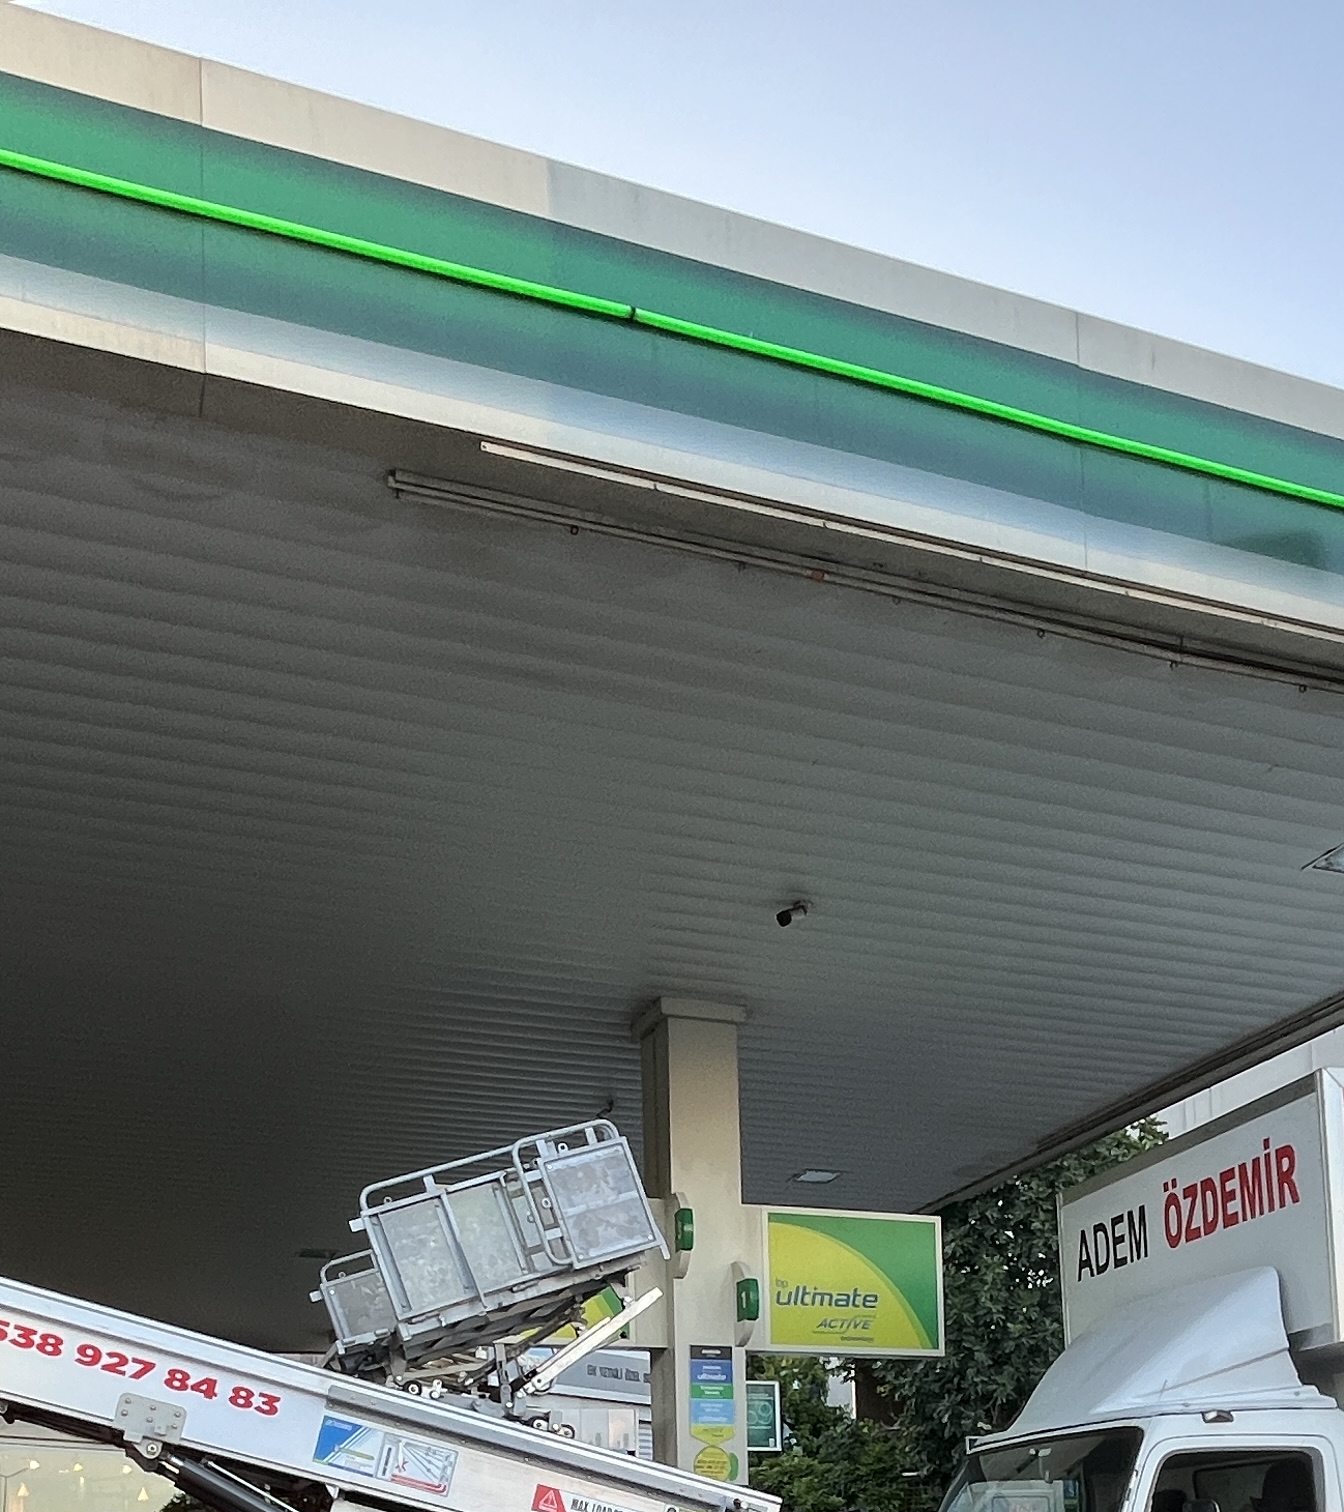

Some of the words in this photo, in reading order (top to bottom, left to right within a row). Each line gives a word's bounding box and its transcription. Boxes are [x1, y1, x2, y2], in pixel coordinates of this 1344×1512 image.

[1077, 1204, 1149, 1282] ADEM
[1163, 1136, 1301, 1249] ÖZDEMİR
[776, 1285, 878, 1309] ultimate
[816, 1318, 873, 1330] ACTIVE
[76, 1343, 156, 1381] 927
[164, 1368, 219, 1401] 84
[228, 1386, 282, 1417] 83
